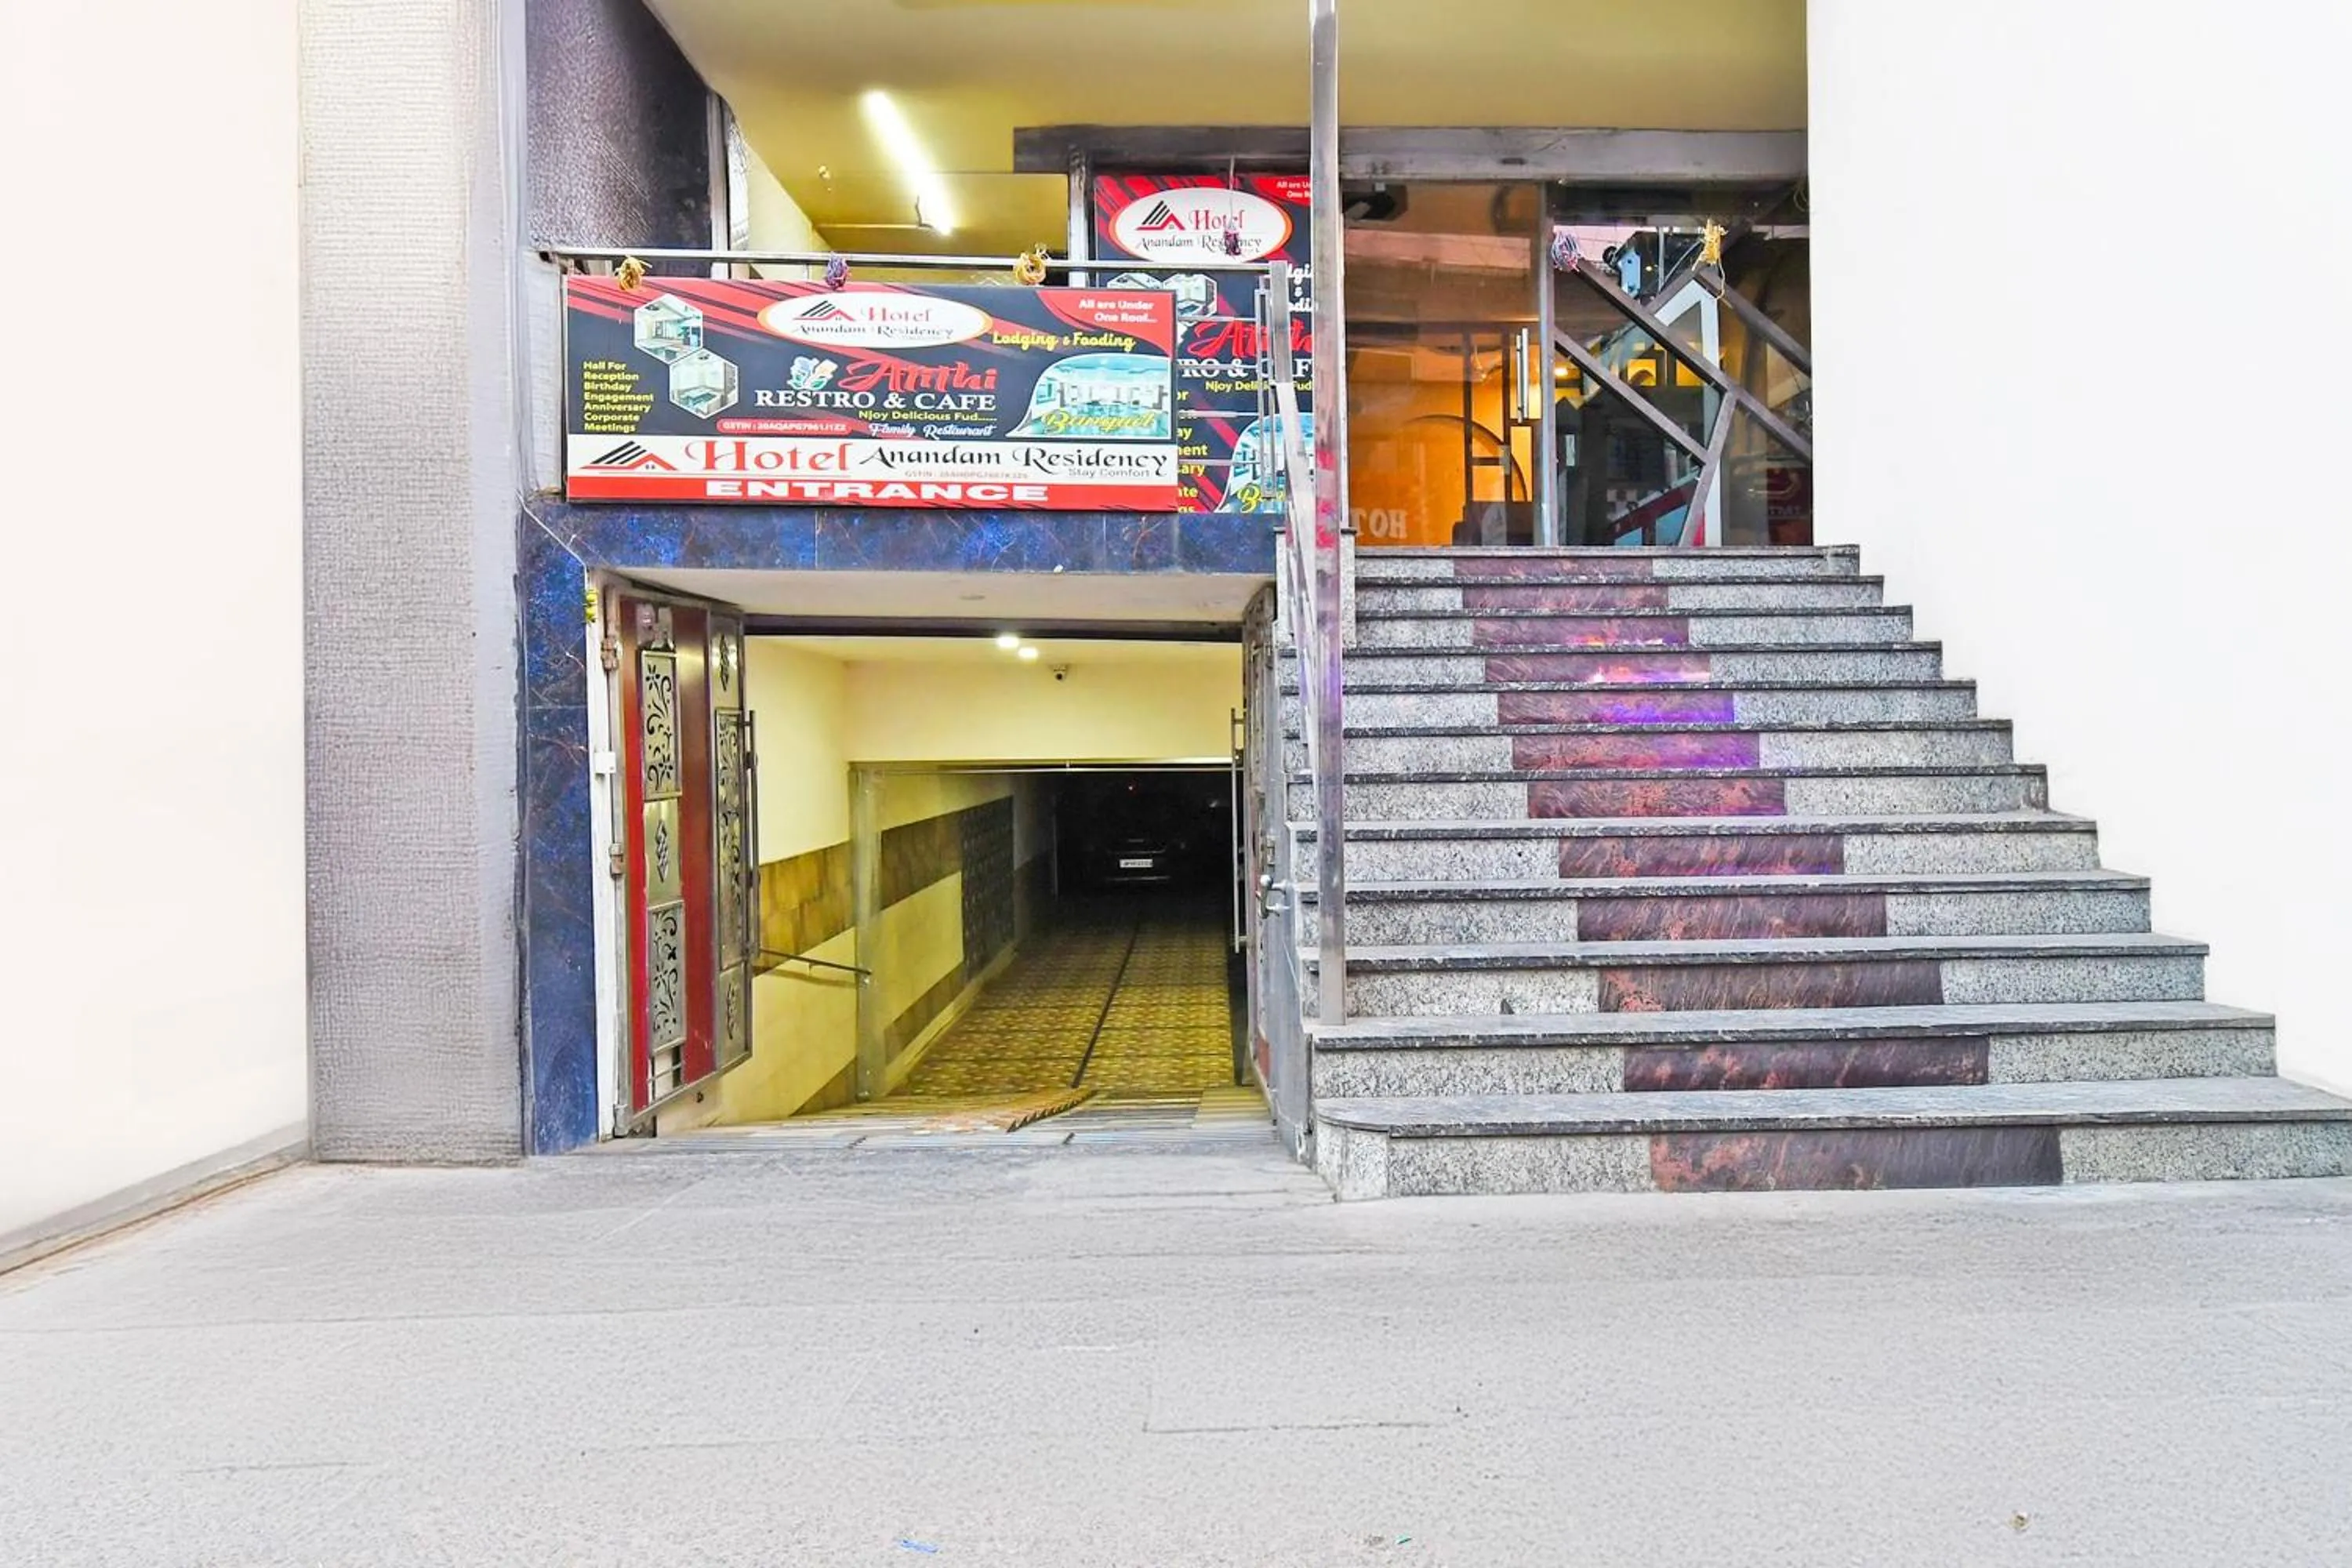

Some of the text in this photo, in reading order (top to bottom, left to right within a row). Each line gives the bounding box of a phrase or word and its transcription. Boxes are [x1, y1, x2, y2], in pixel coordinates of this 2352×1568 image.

[1136, 235, 1193, 251] Anandam
[1078, 299, 1095, 309] All
[1117, 300, 1154, 310] Under
[860, 306, 932, 322] Hotel
[1094, 312, 1119, 322] One
[793, 323, 866, 336] Anandam
[873, 324, 954, 339] Residency
[993, 331, 1058, 350] Lodging
[1072, 332, 1136, 353] Fooding
[583, 361, 626, 371] Hall For
[583, 371, 640, 382] Reception
[583, 381, 632, 393] Birthday
[583, 392, 654, 402] Engagement
[753, 390, 996, 411] RESTRO & CAFE
[583, 402, 652, 414] Anniversary
[583, 412, 641, 423] Corporate
[858, 411, 889, 422] Njoy
[891, 412, 951, 422] Delicious
[583, 423, 637, 434] Meetings
[868, 423, 997, 441] Family Restaurant
[684, 440, 853, 471] Hotel
[858, 445, 1001, 469] Anandam
[1012, 448, 1167, 477] Residency
[1069, 468, 1150, 478] Stay Comfort
[706, 480, 1049, 503] ENTRANCE
